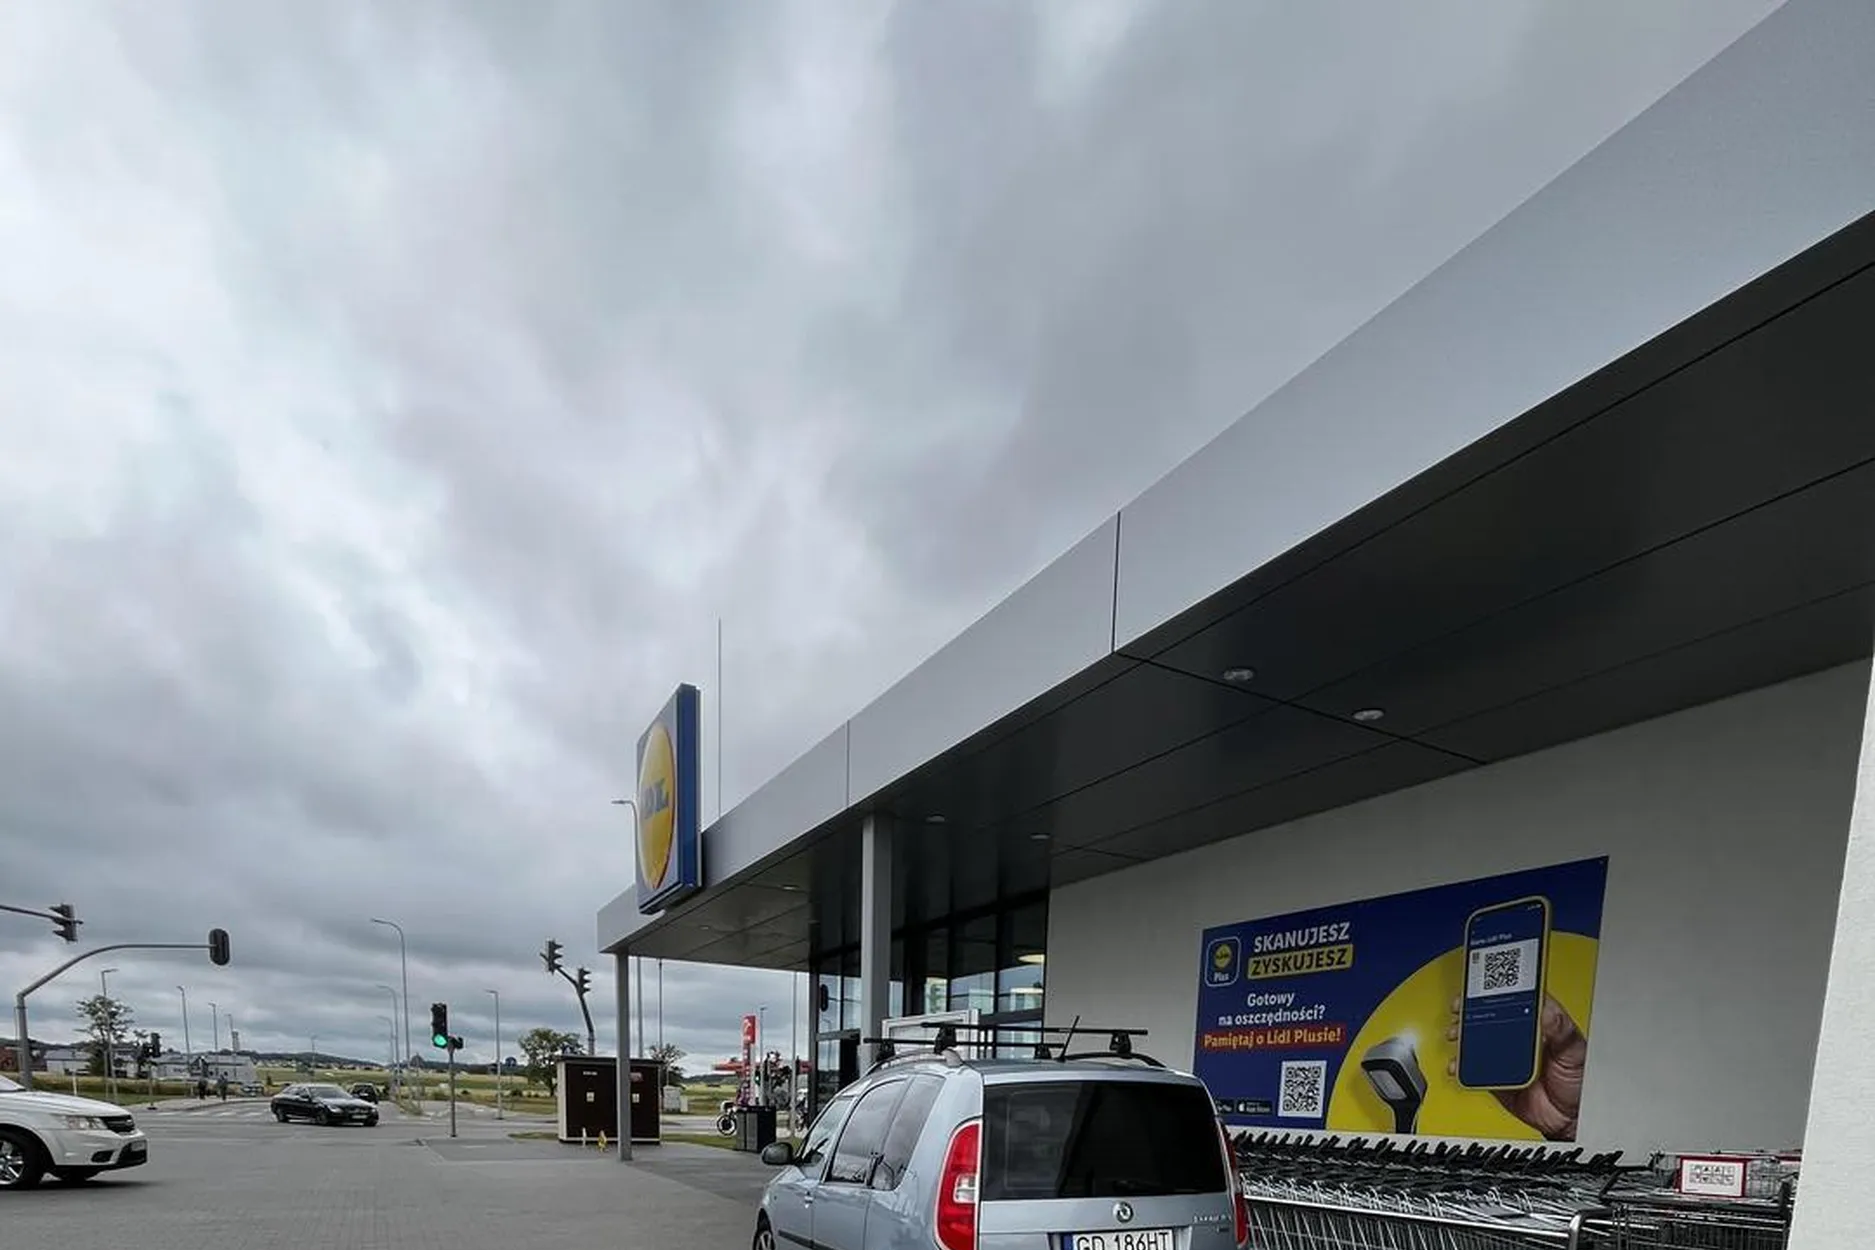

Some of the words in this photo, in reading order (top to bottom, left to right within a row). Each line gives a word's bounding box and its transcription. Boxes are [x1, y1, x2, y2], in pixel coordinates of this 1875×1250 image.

[1254, 922, 1350, 953] SKANUJESZ
[1251, 948, 1347, 975] ZYSKUJESZ
[1247, 993, 1295, 1007] Gotowy
[1218, 1015, 1233, 1026] na
[1235, 1005, 1326, 1026] oszczędności?
[1204, 1030, 1254, 1049] Pamiętaj
[1256, 1034, 1264, 1044] o
[1267, 1030, 1291, 1045] Lidl
[1294, 1027, 1341, 1043] Plusie!
